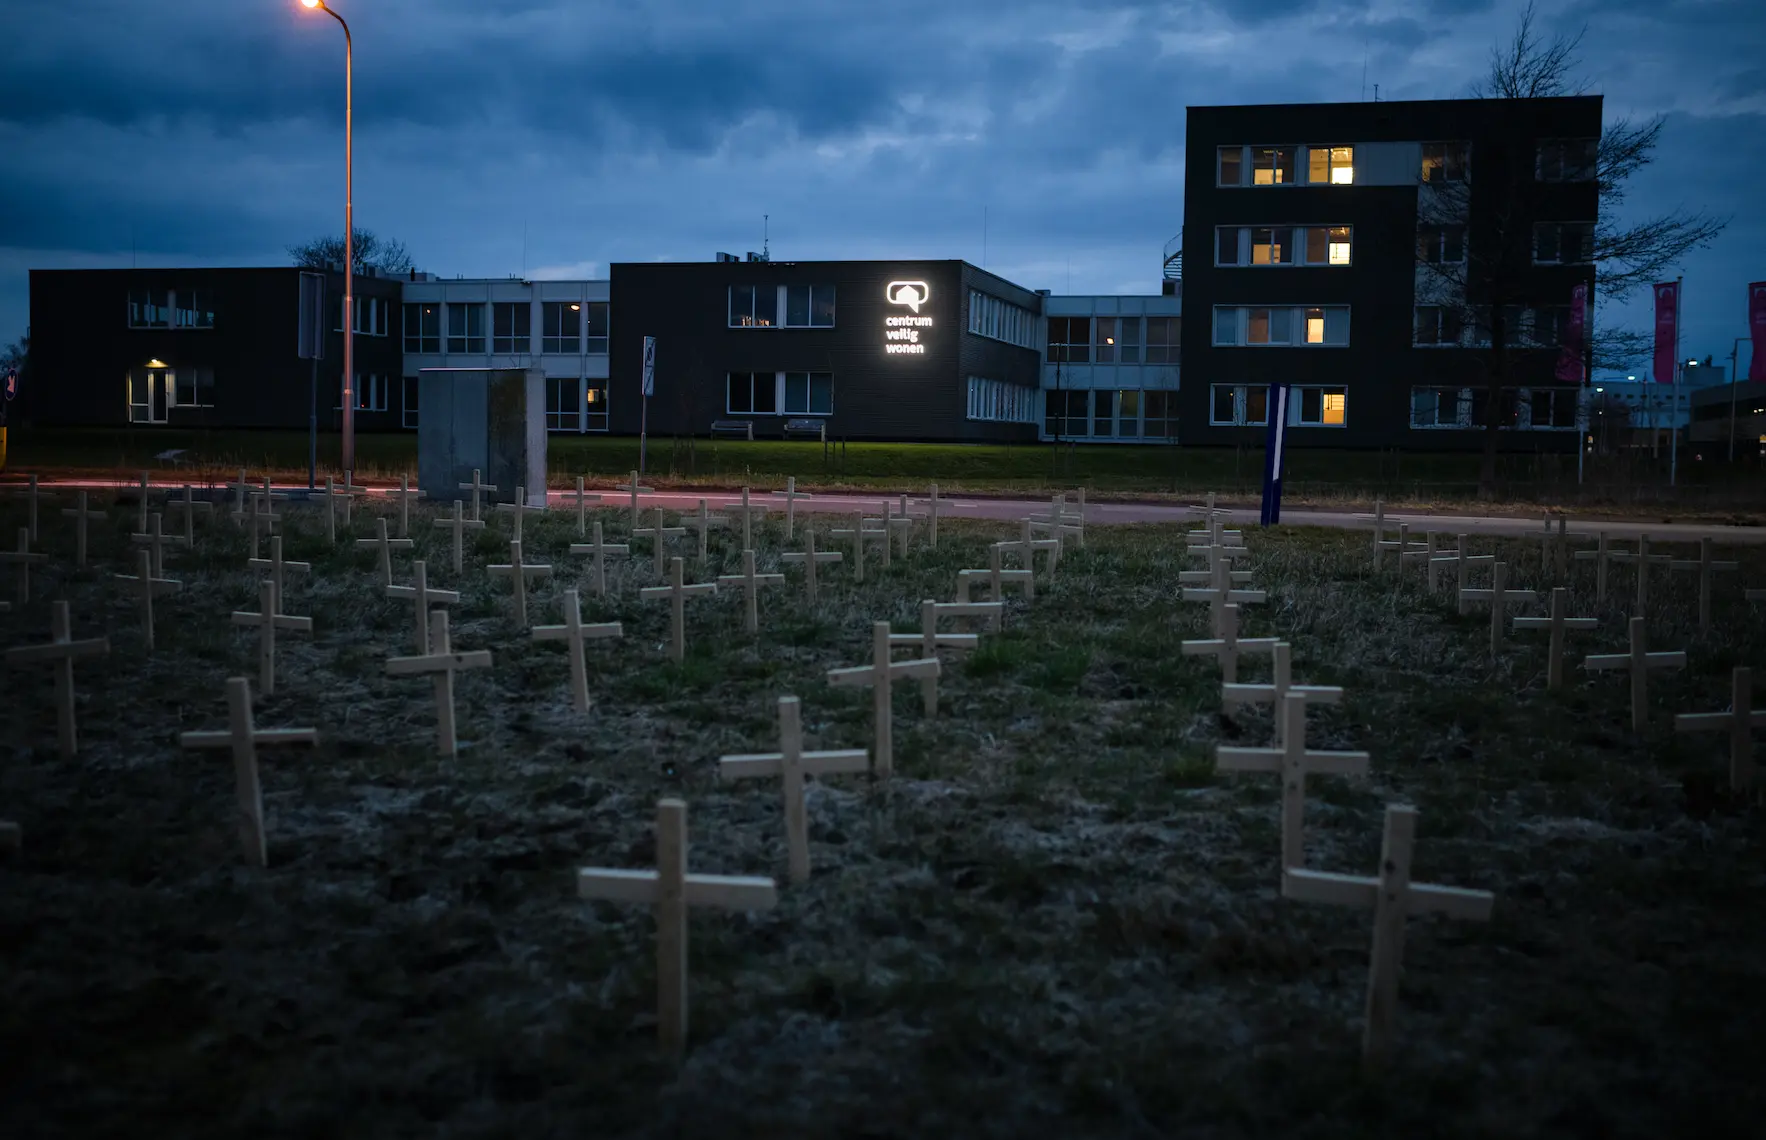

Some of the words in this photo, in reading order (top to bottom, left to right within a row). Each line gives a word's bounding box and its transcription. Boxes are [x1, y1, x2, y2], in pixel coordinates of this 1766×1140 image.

[886, 315, 932, 326] centrum
[886, 328, 919, 343] veilig
[886, 344, 924, 353] wonen
